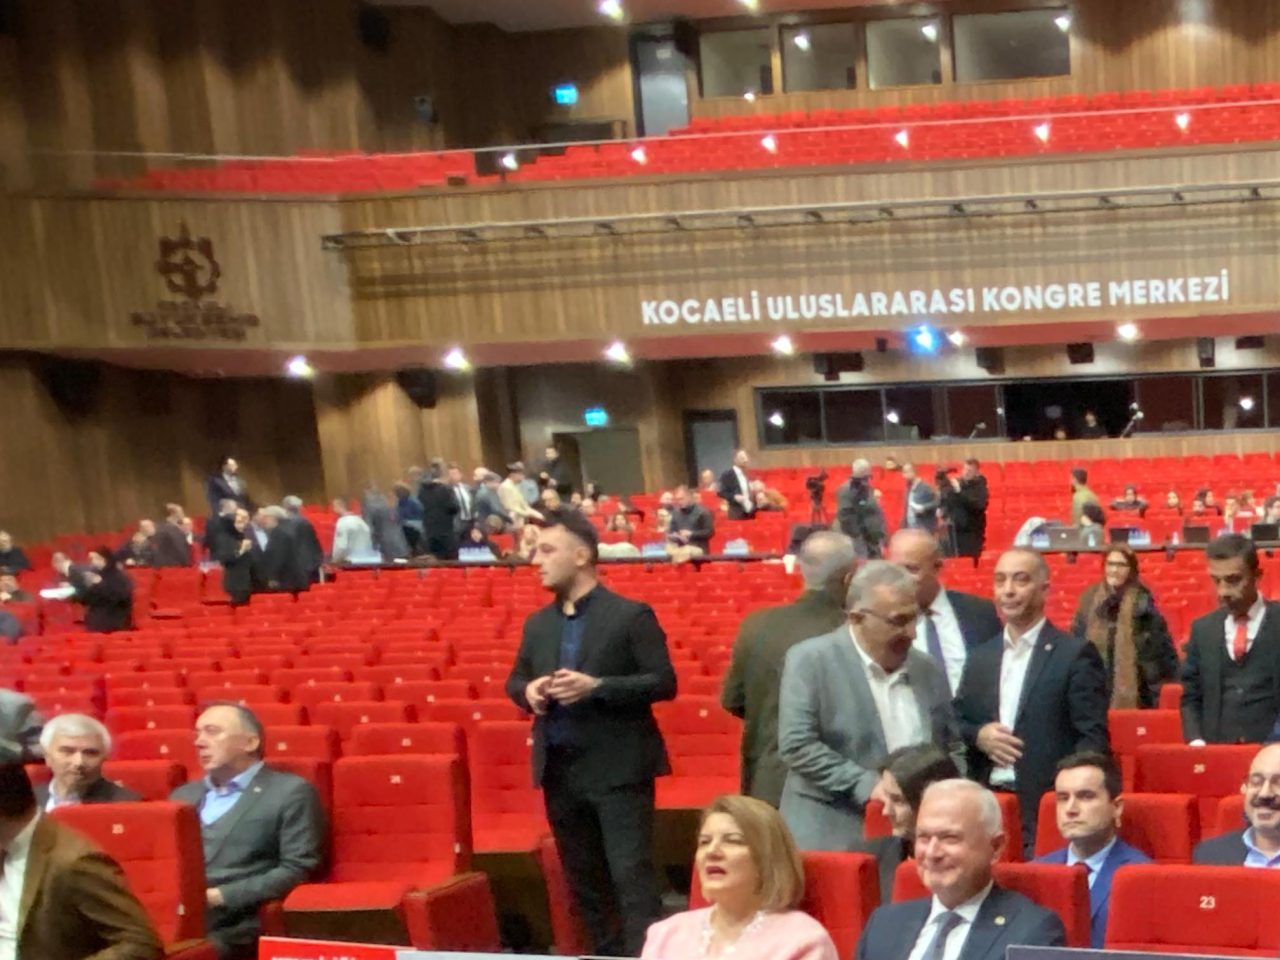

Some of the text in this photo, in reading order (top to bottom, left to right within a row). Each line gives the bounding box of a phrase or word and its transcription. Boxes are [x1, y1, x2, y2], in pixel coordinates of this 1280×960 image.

[641, 268, 1229, 325] KOCAELİ ULUSLARARASI KONGRE MERKEZİ
[1199, 895, 1216, 909] 23
